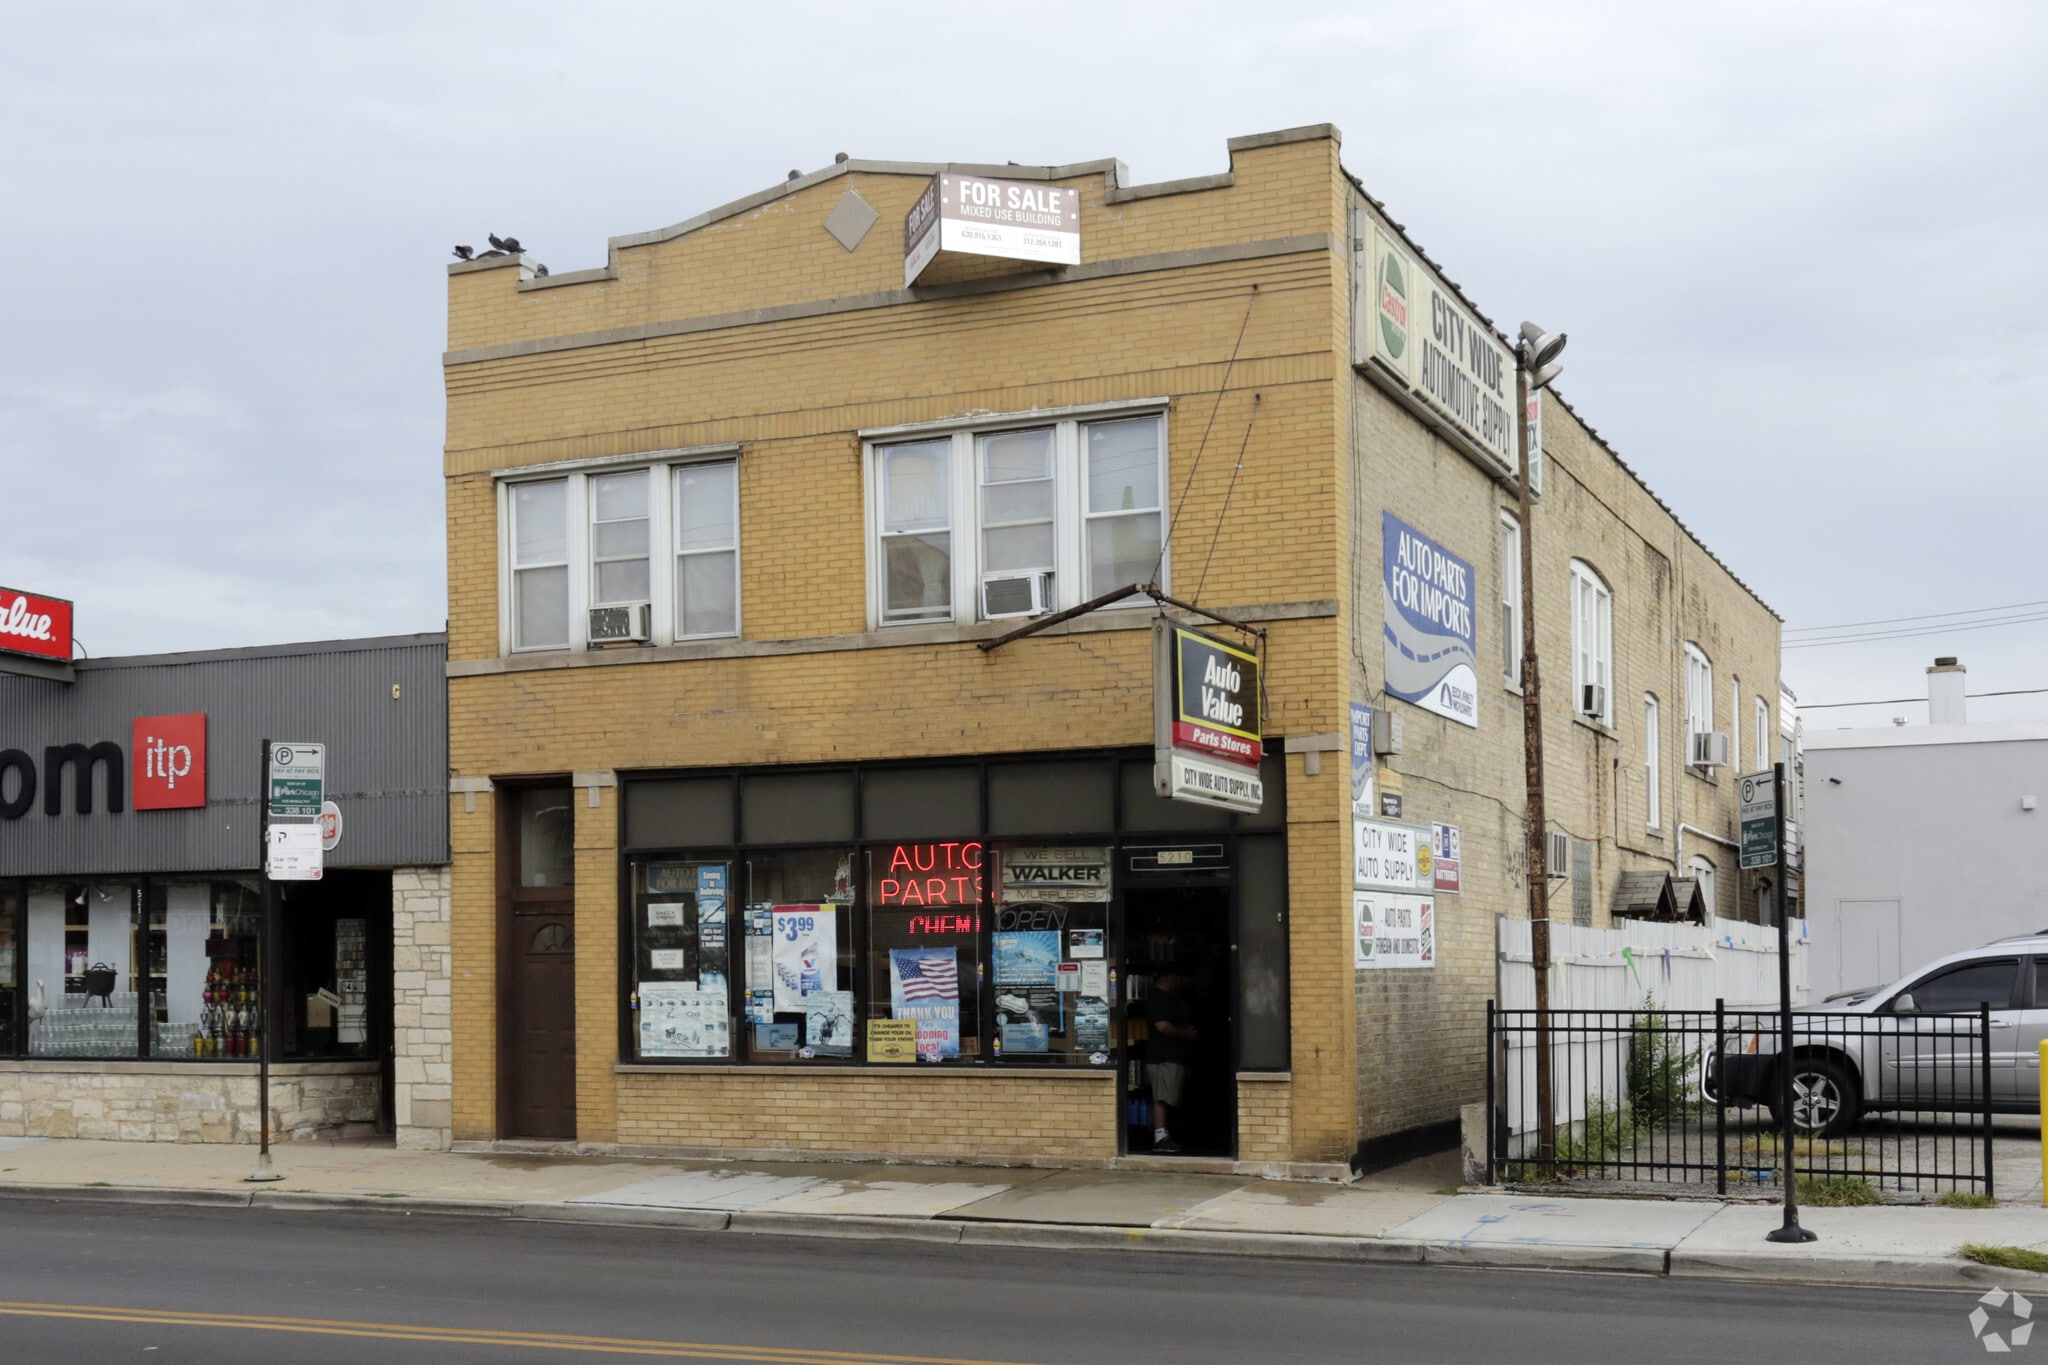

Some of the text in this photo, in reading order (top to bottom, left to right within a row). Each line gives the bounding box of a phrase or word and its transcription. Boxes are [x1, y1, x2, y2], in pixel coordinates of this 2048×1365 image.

[959, 180, 1061, 214] FOR SALE
[960, 204, 1062, 226] MIXED USE BUILDING
[1431, 290, 1504, 400] CITY WIDE
[1422, 338, 1511, 458] AUTOMOTIVE SUPPLY
[1527, 422, 1537, 451] TX
[1398, 531, 1466, 601] AUTO PARTS
[1392, 565, 1470, 639] FOR IMPORTS
[1203, 654, 1240, 694] Auto
[1201, 685, 1243, 727] Value
[1192, 728, 1251, 755] Parts Stores
[1354, 727, 1369, 742] PARTS
[147, 736, 191, 789] itp
[1184, 767, 1197, 785] CITY
[1198, 770, 1213, 789] WIDE
[1214, 774, 1229, 793] AUTO
[285, 806, 316, 815] 338 101
[1362, 826, 1382, 848] CITY
[1387, 831, 1407, 853] WIDE
[890, 842, 983, 873] AUTO
[1023, 849, 1090, 860] WE SELL
[1159, 852, 1192, 863] 5210
[661, 867, 689, 878] AUTO
[1012, 865, 1101, 881] WALKER
[1358, 856, 1379, 878] AUTO
[1384, 859, 1413, 881] SUPPLY
[1016, 888, 1097, 899] MUFFLERS
[1000, 910, 1068, 930] OPEN
[897, 1006, 955, 1020] THANK YOU
[915, 1030, 948, 1041] opping
